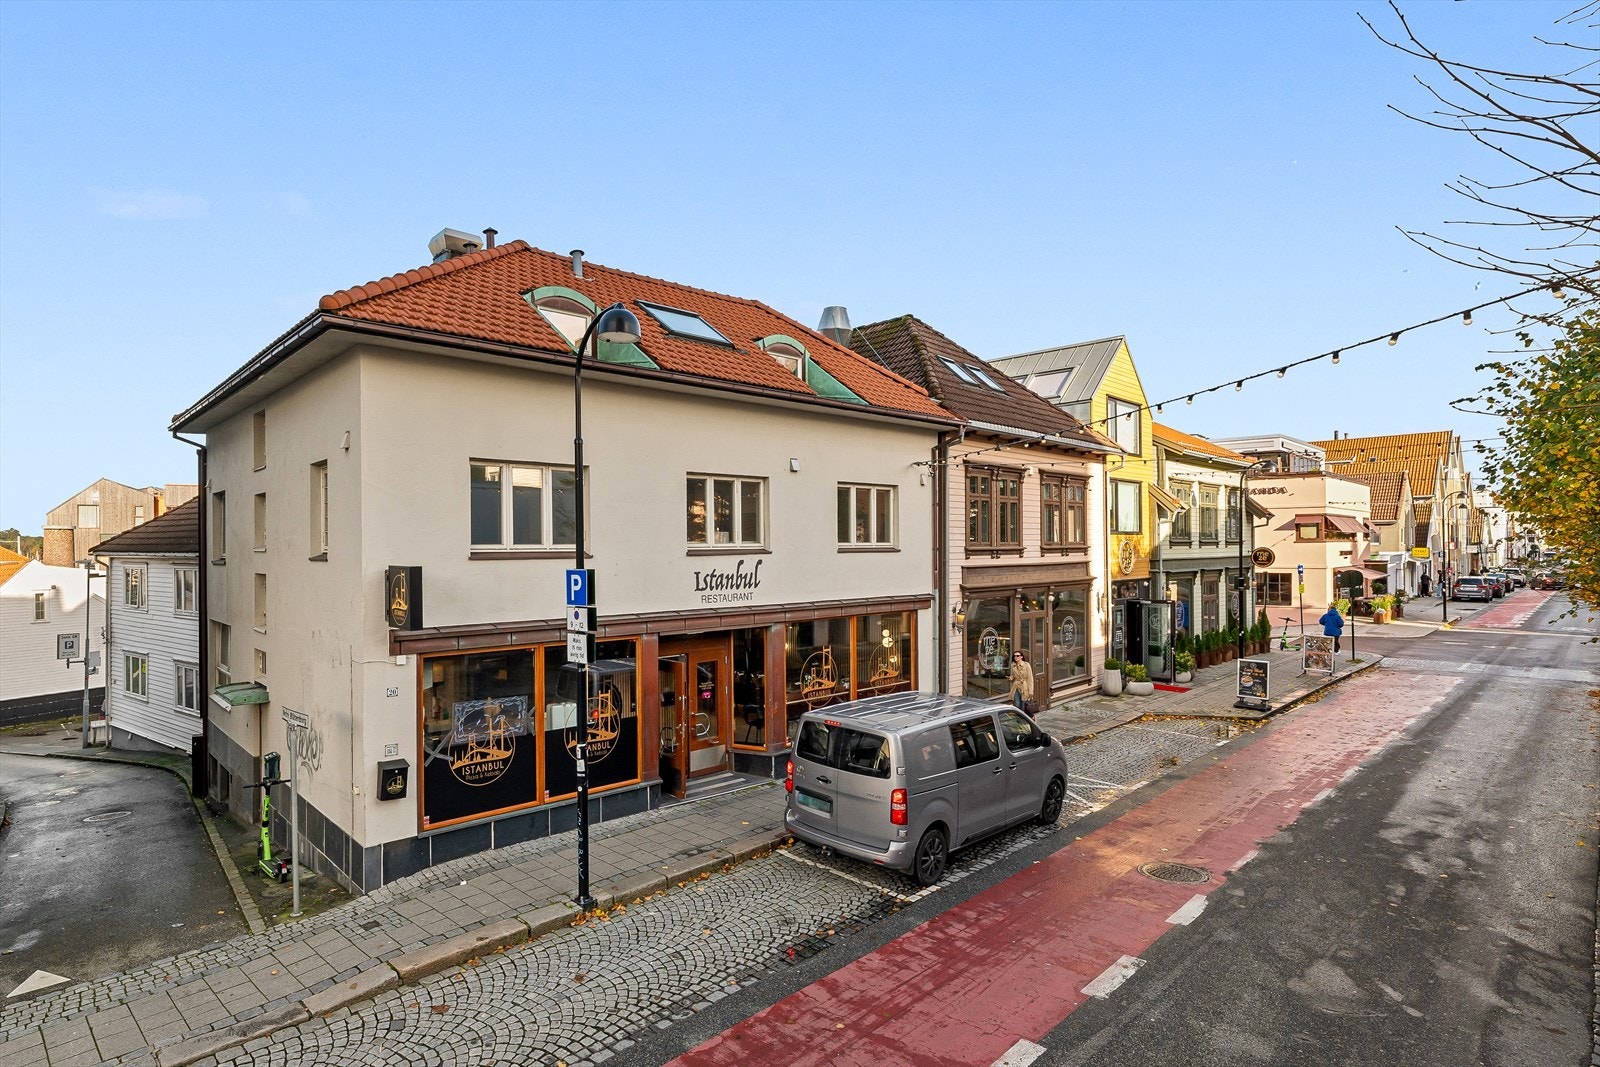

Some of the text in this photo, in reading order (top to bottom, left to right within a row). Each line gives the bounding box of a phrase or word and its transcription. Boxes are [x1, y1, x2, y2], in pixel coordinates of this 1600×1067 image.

[694, 559, 763, 592] Istanbul
[570, 574, 582, 601] P
[701, 592, 754, 604] RESTAURANT
[66, 641, 73, 649] P
[984, 636, 996, 646] me
[388, 688, 397, 696] 20
[462, 761, 505, 775] ISTANBUL
